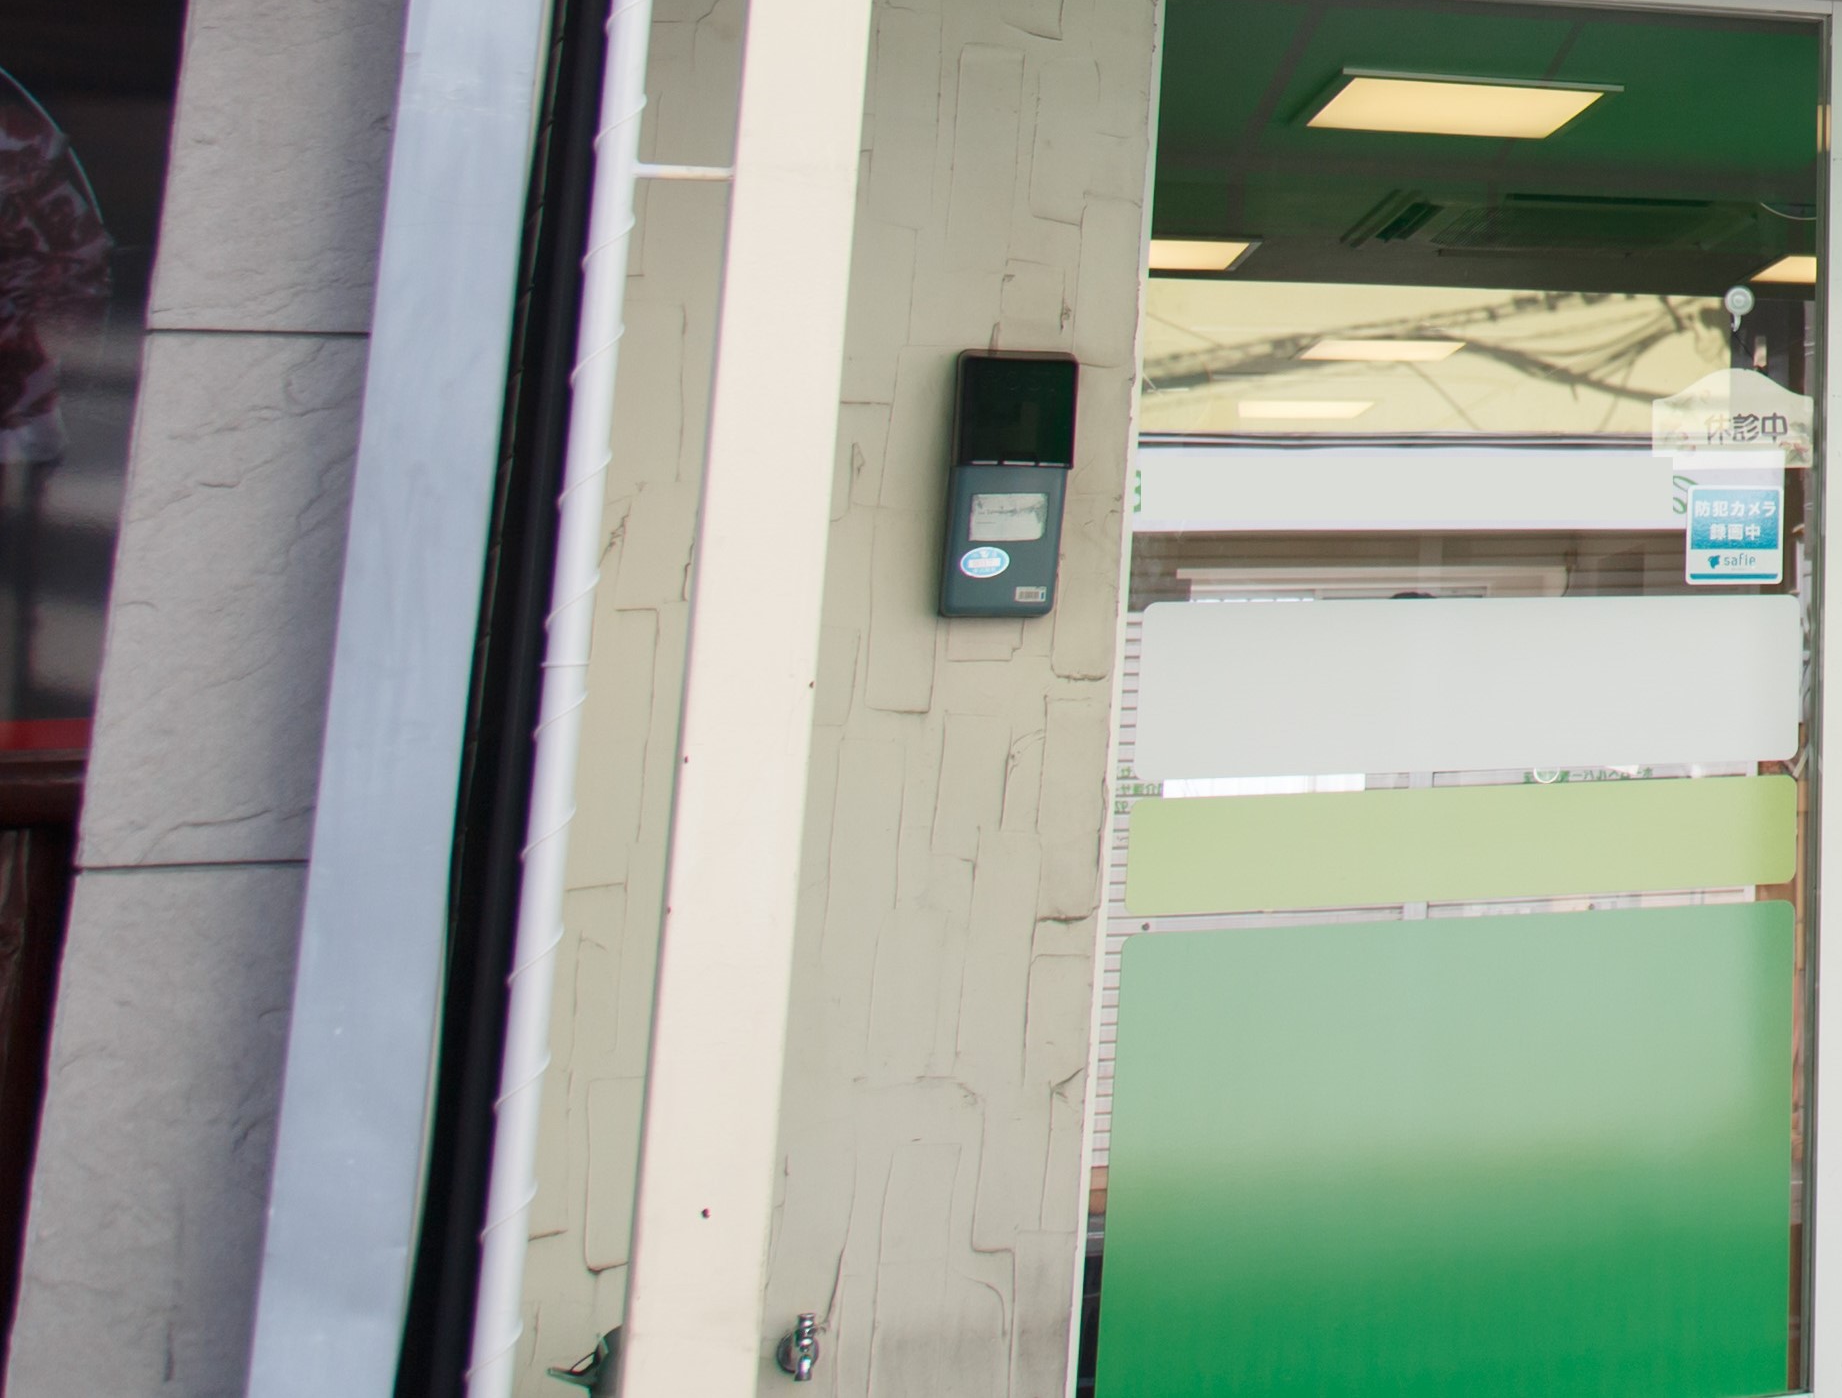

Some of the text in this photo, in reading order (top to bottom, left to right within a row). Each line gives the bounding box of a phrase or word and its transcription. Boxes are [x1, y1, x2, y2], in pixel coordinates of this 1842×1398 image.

[1704, 413, 1788, 445] 休診中
[1694, 501, 1777, 517] 防犯カメラ
[1709, 523, 1761, 541] 録画中
[1724, 553, 1756, 567] safie
